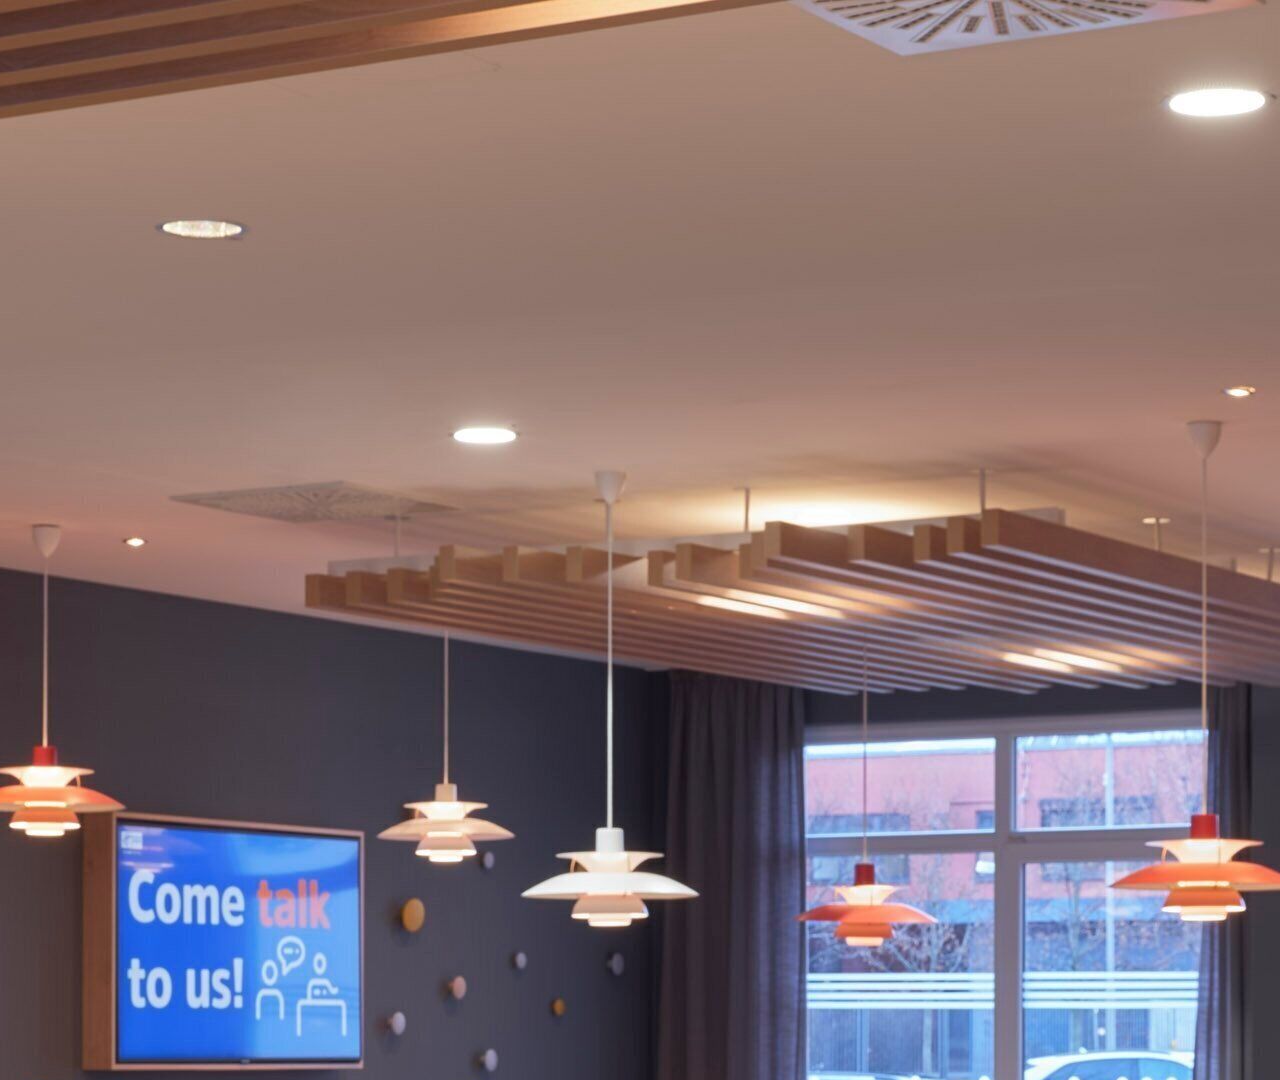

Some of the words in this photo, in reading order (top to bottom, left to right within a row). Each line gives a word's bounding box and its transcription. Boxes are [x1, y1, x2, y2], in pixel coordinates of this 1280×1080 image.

[128, 868, 246, 927] Come
[256, 879, 331, 930] talk
[127, 957, 173, 1009] to
[185, 957, 244, 1009] us!
